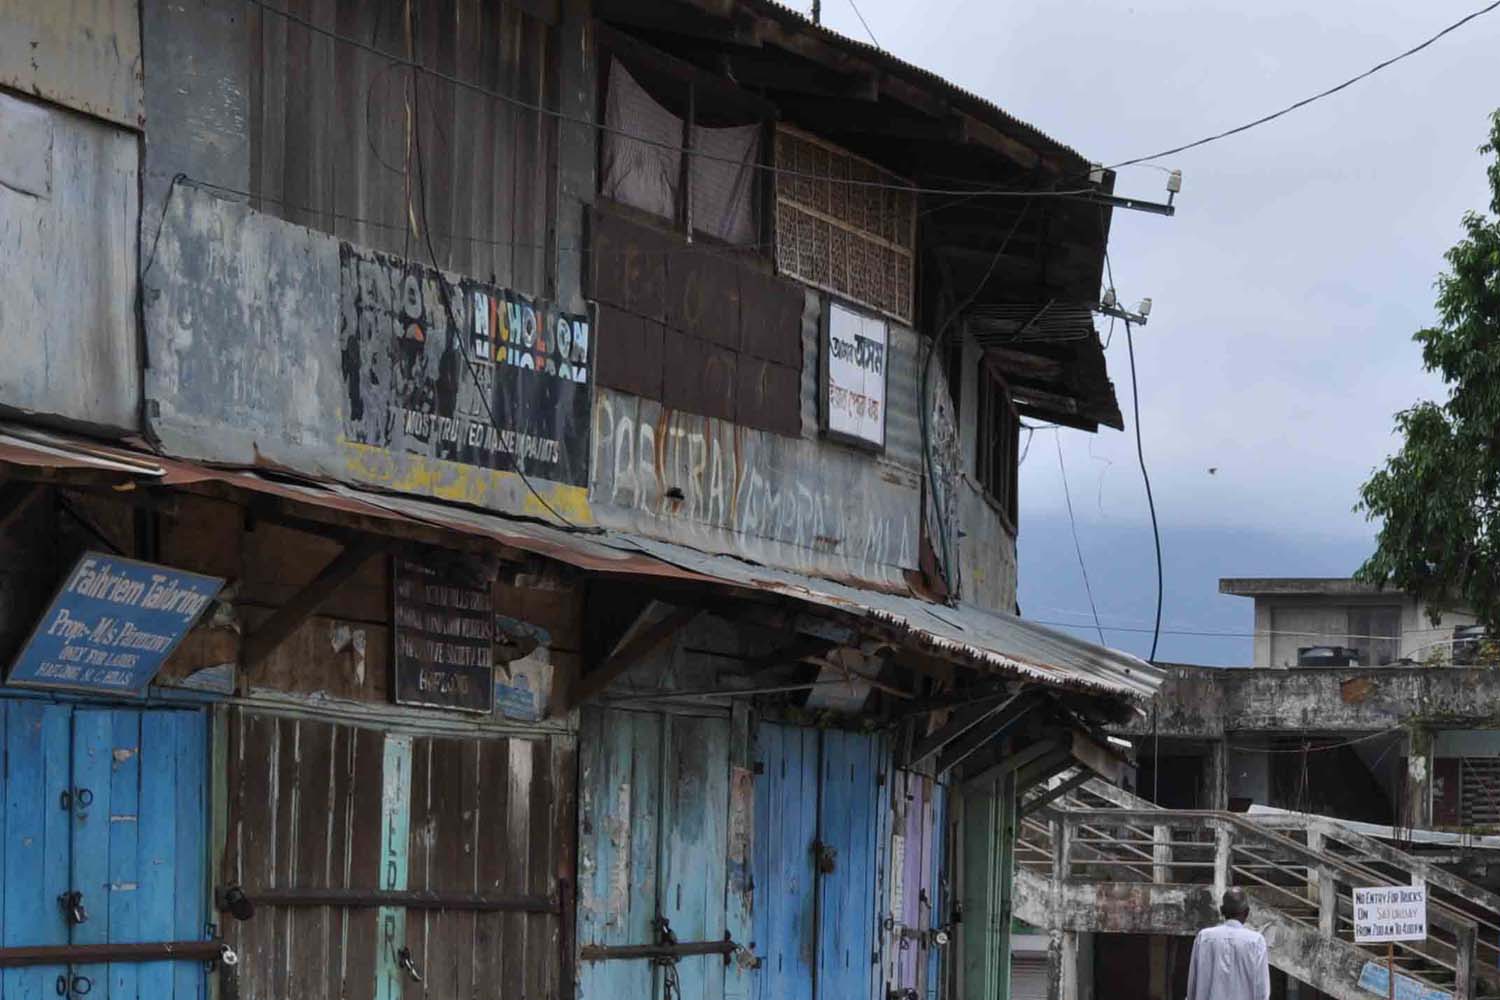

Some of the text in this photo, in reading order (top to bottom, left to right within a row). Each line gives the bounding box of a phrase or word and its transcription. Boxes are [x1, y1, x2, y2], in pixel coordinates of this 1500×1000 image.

[474, 291, 589, 364] NICHOLSON
[1366, 891, 1386, 904] ENTRY
[1387, 891, 1399, 903] FOR
[1358, 907, 1368, 920] ON
